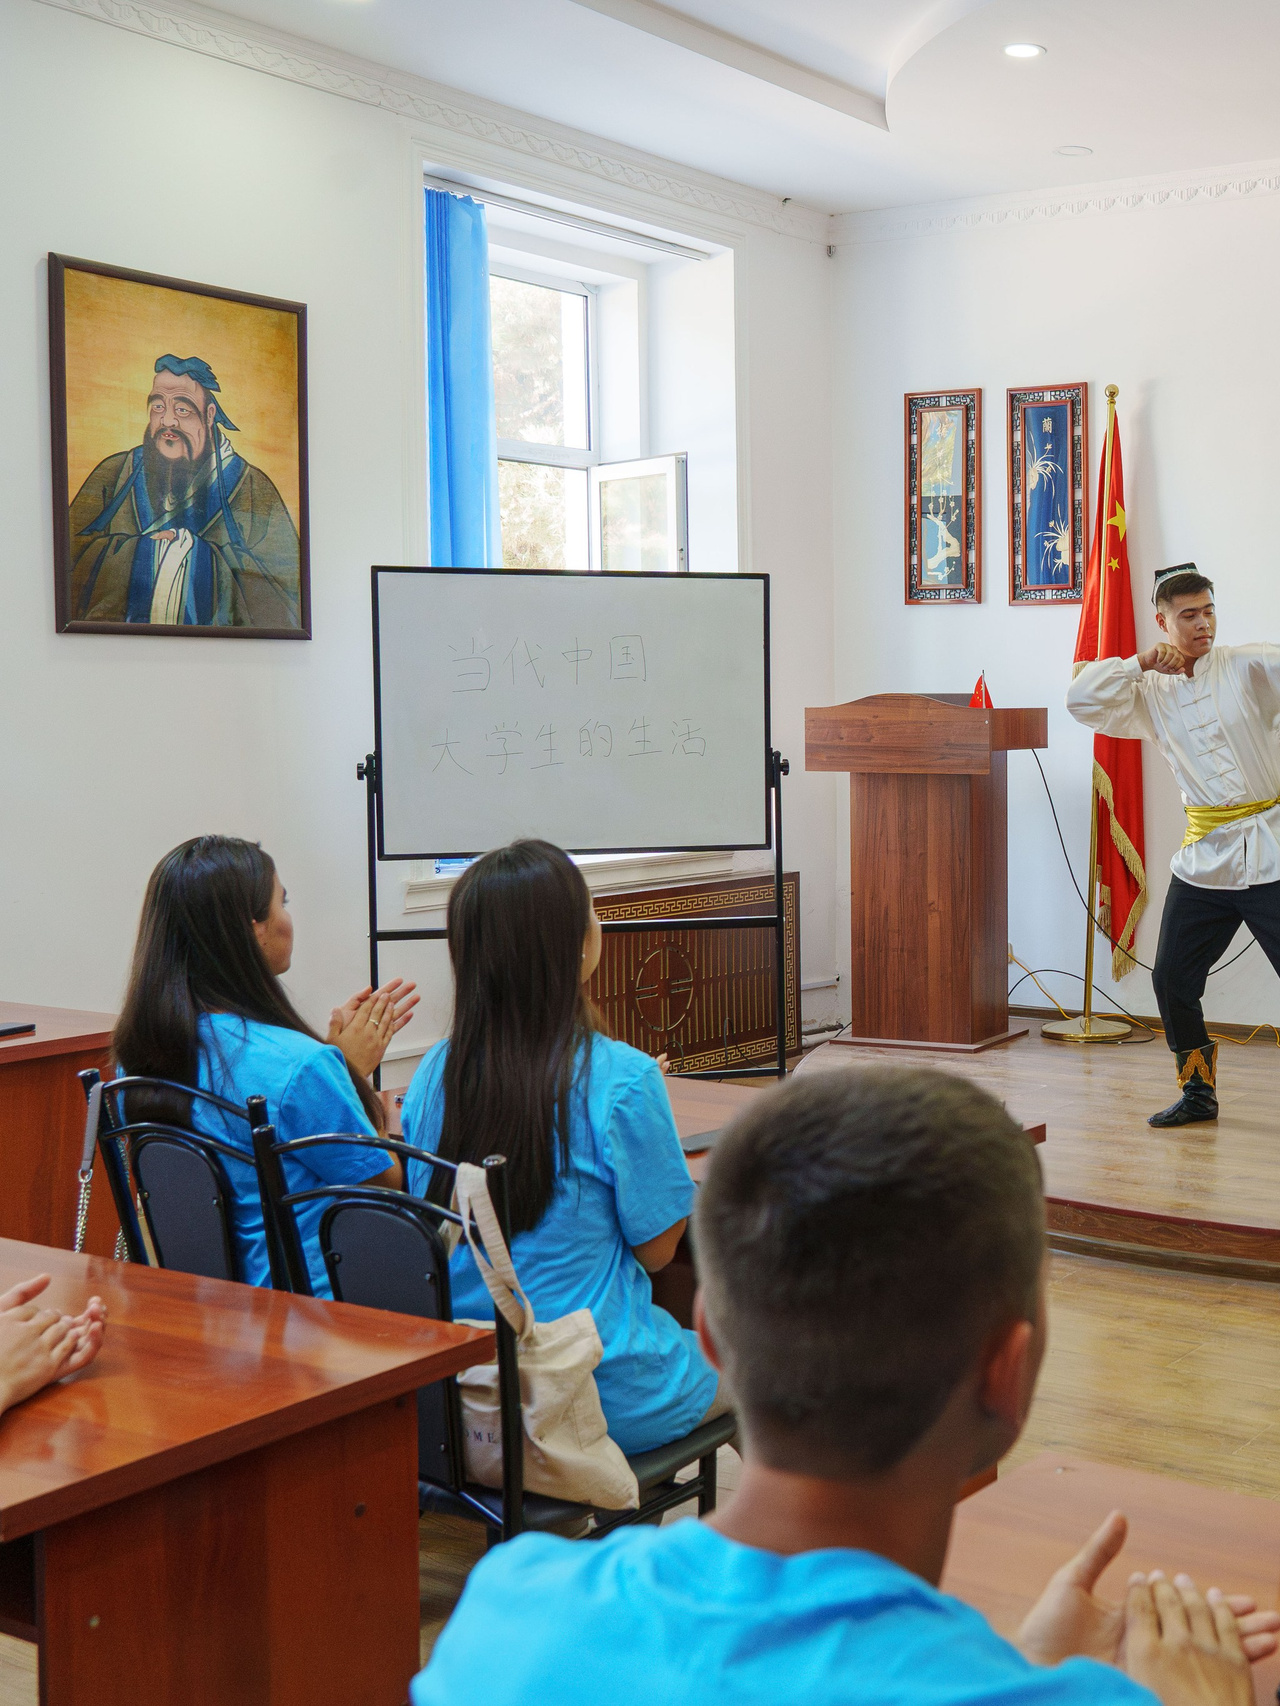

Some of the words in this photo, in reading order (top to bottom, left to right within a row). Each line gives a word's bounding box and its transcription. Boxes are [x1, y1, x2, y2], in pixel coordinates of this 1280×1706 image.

[447, 634, 647, 693] 当代中国
[431, 716, 706, 776] 大学生的生活
